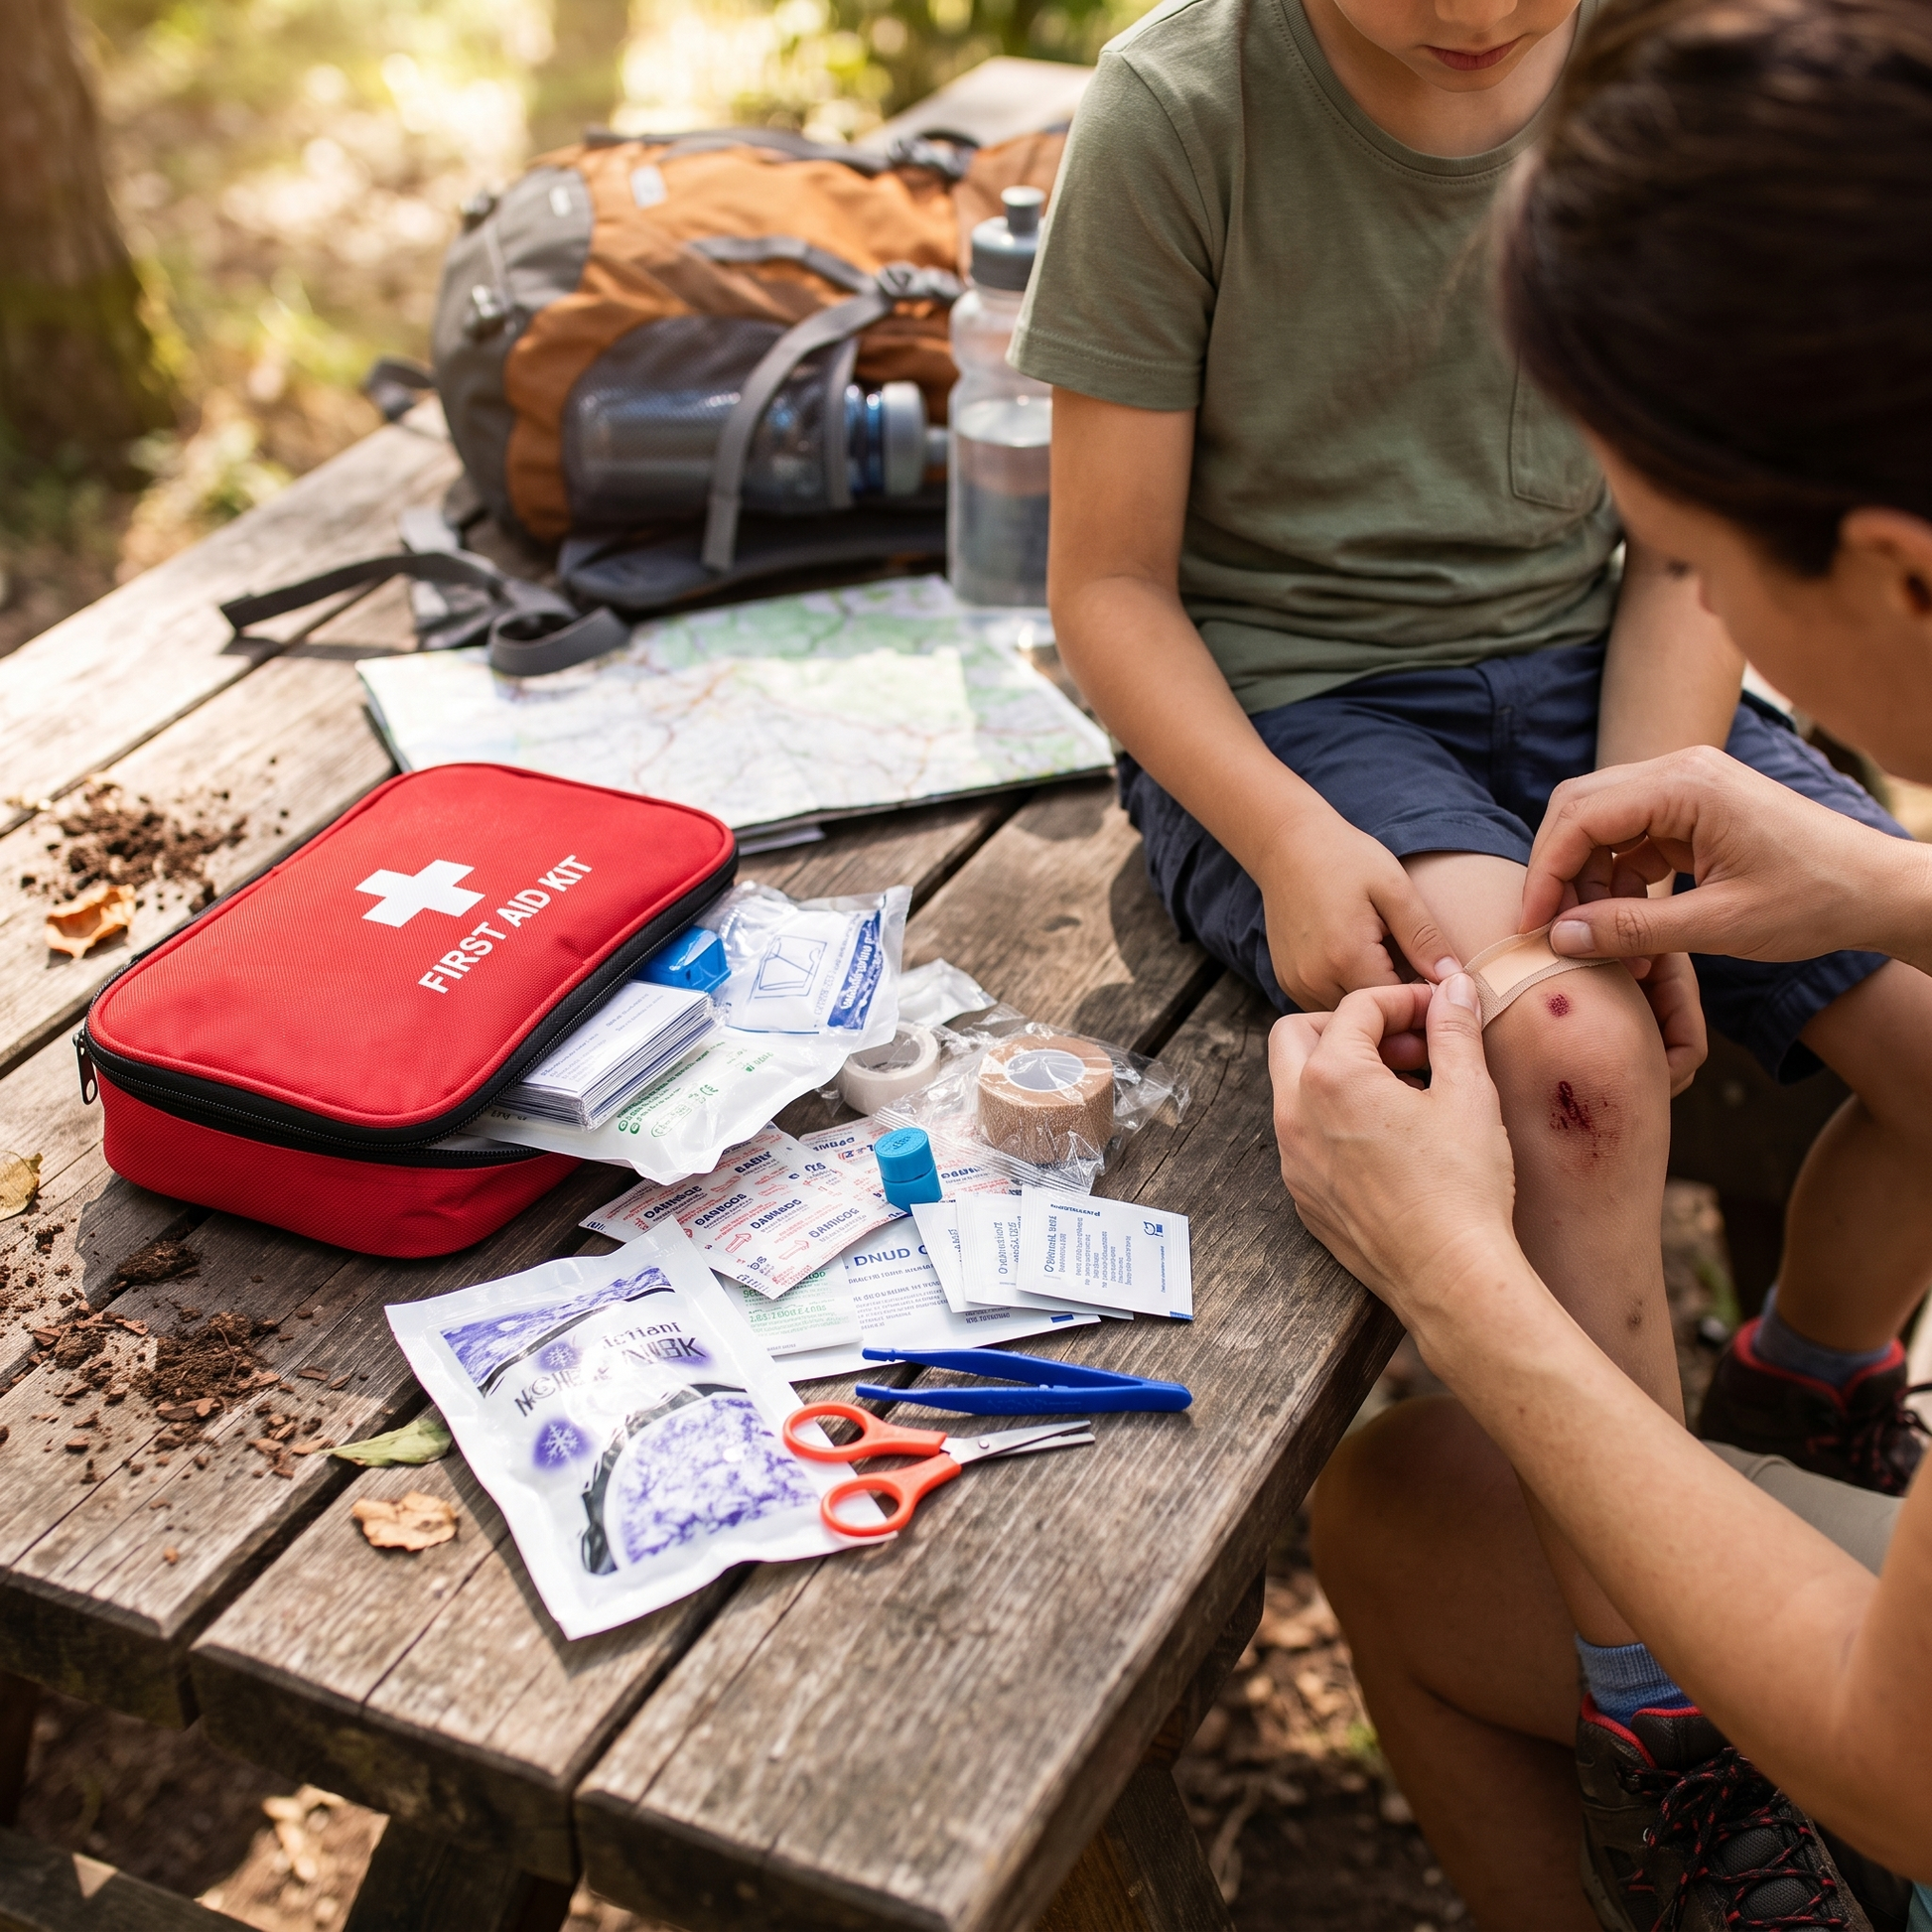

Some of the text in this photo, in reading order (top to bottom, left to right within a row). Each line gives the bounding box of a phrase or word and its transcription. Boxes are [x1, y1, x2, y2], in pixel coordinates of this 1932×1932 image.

[418, 855, 593, 994] FIRST AID KIT
[854, 1248, 910, 1267] DNUD
